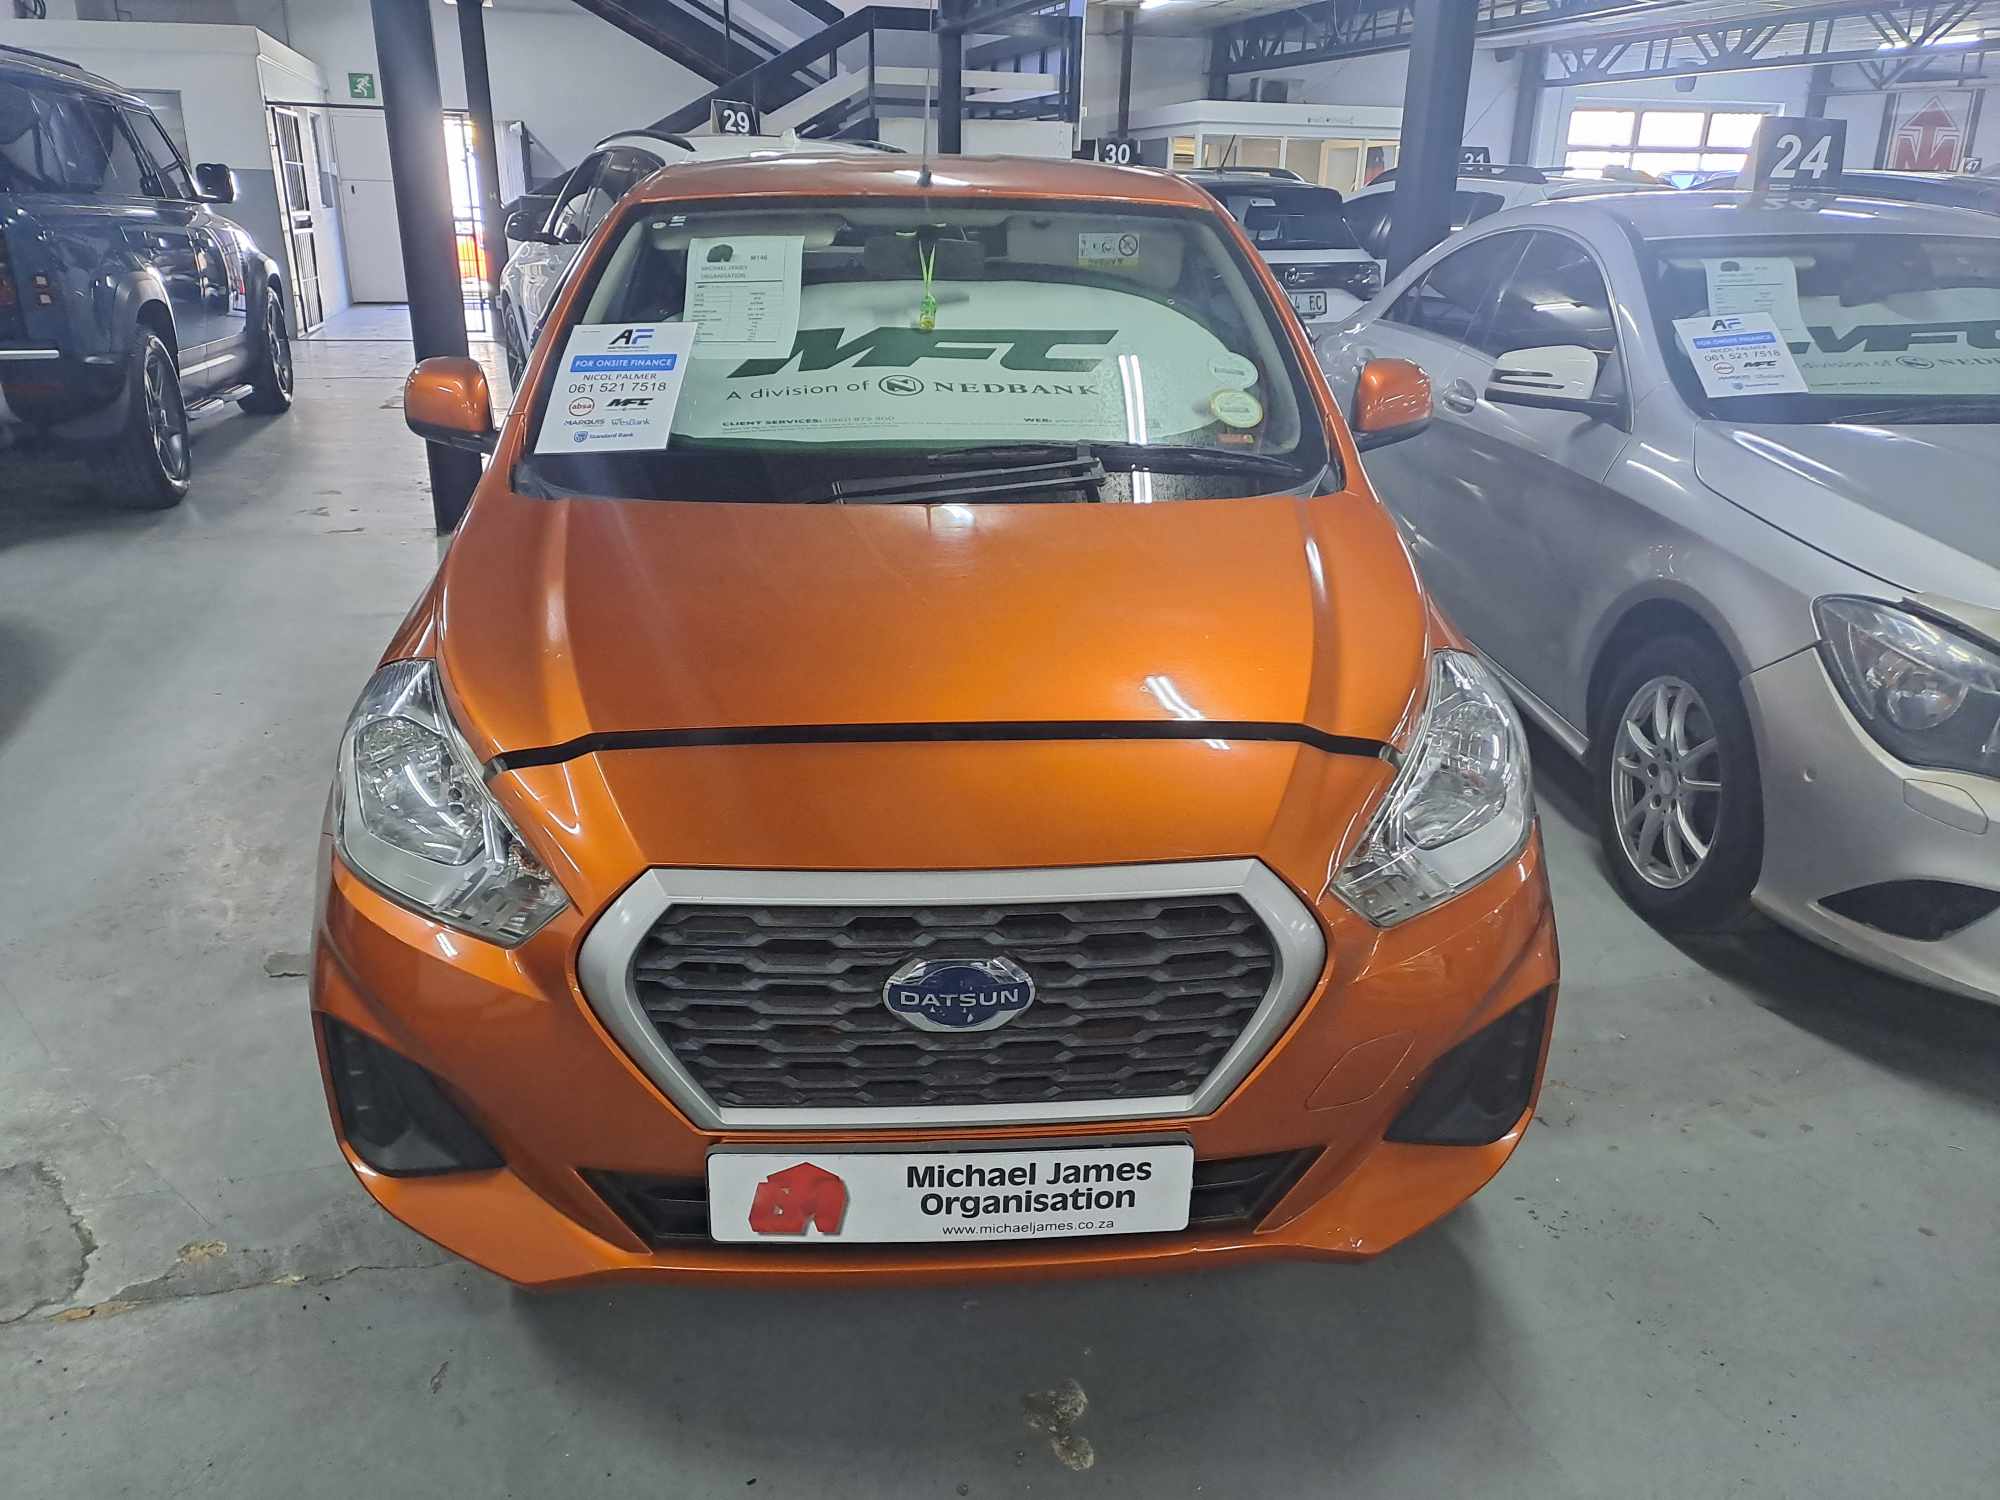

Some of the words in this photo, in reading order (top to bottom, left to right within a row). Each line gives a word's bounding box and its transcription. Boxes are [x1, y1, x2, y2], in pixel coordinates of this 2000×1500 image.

[723, 109, 750, 133] 29
[1104, 143, 1130, 164] 30
[1769, 134, 1832, 180] 24
[1711, 317, 1742, 331] AF
[608, 328, 655, 345] AF
[727, 326, 1119, 378] MFC
[1729, 351, 1748, 360] 521
[575, 360, 595, 368] FOR
[596, 359, 630, 367] ONSITE
[630, 358, 673, 367] FINANCE
[1743, 360, 1777, 368] MFC
[568, 383, 594, 394] 061
[599, 382, 625, 393] 521
[631, 381, 667, 392] 7518
[726, 390, 742, 401] A
[750, 383, 838, 399] division
[846, 380, 870, 393] of
[934, 381, 1101, 395] NEDBANK
[571, 401, 592, 410] absa
[606, 397, 654, 407] MFC
[722, 419, 763, 427] CLIENT
[900, 988, 1019, 1007] DATSUN
[906, 1161, 1036, 1189] Michael
[1046, 1160, 1152, 1186] James
[920, 1187, 1136, 1217] Organisation
[942, 1218, 1114, 1236] www.michaeljames.co.za
